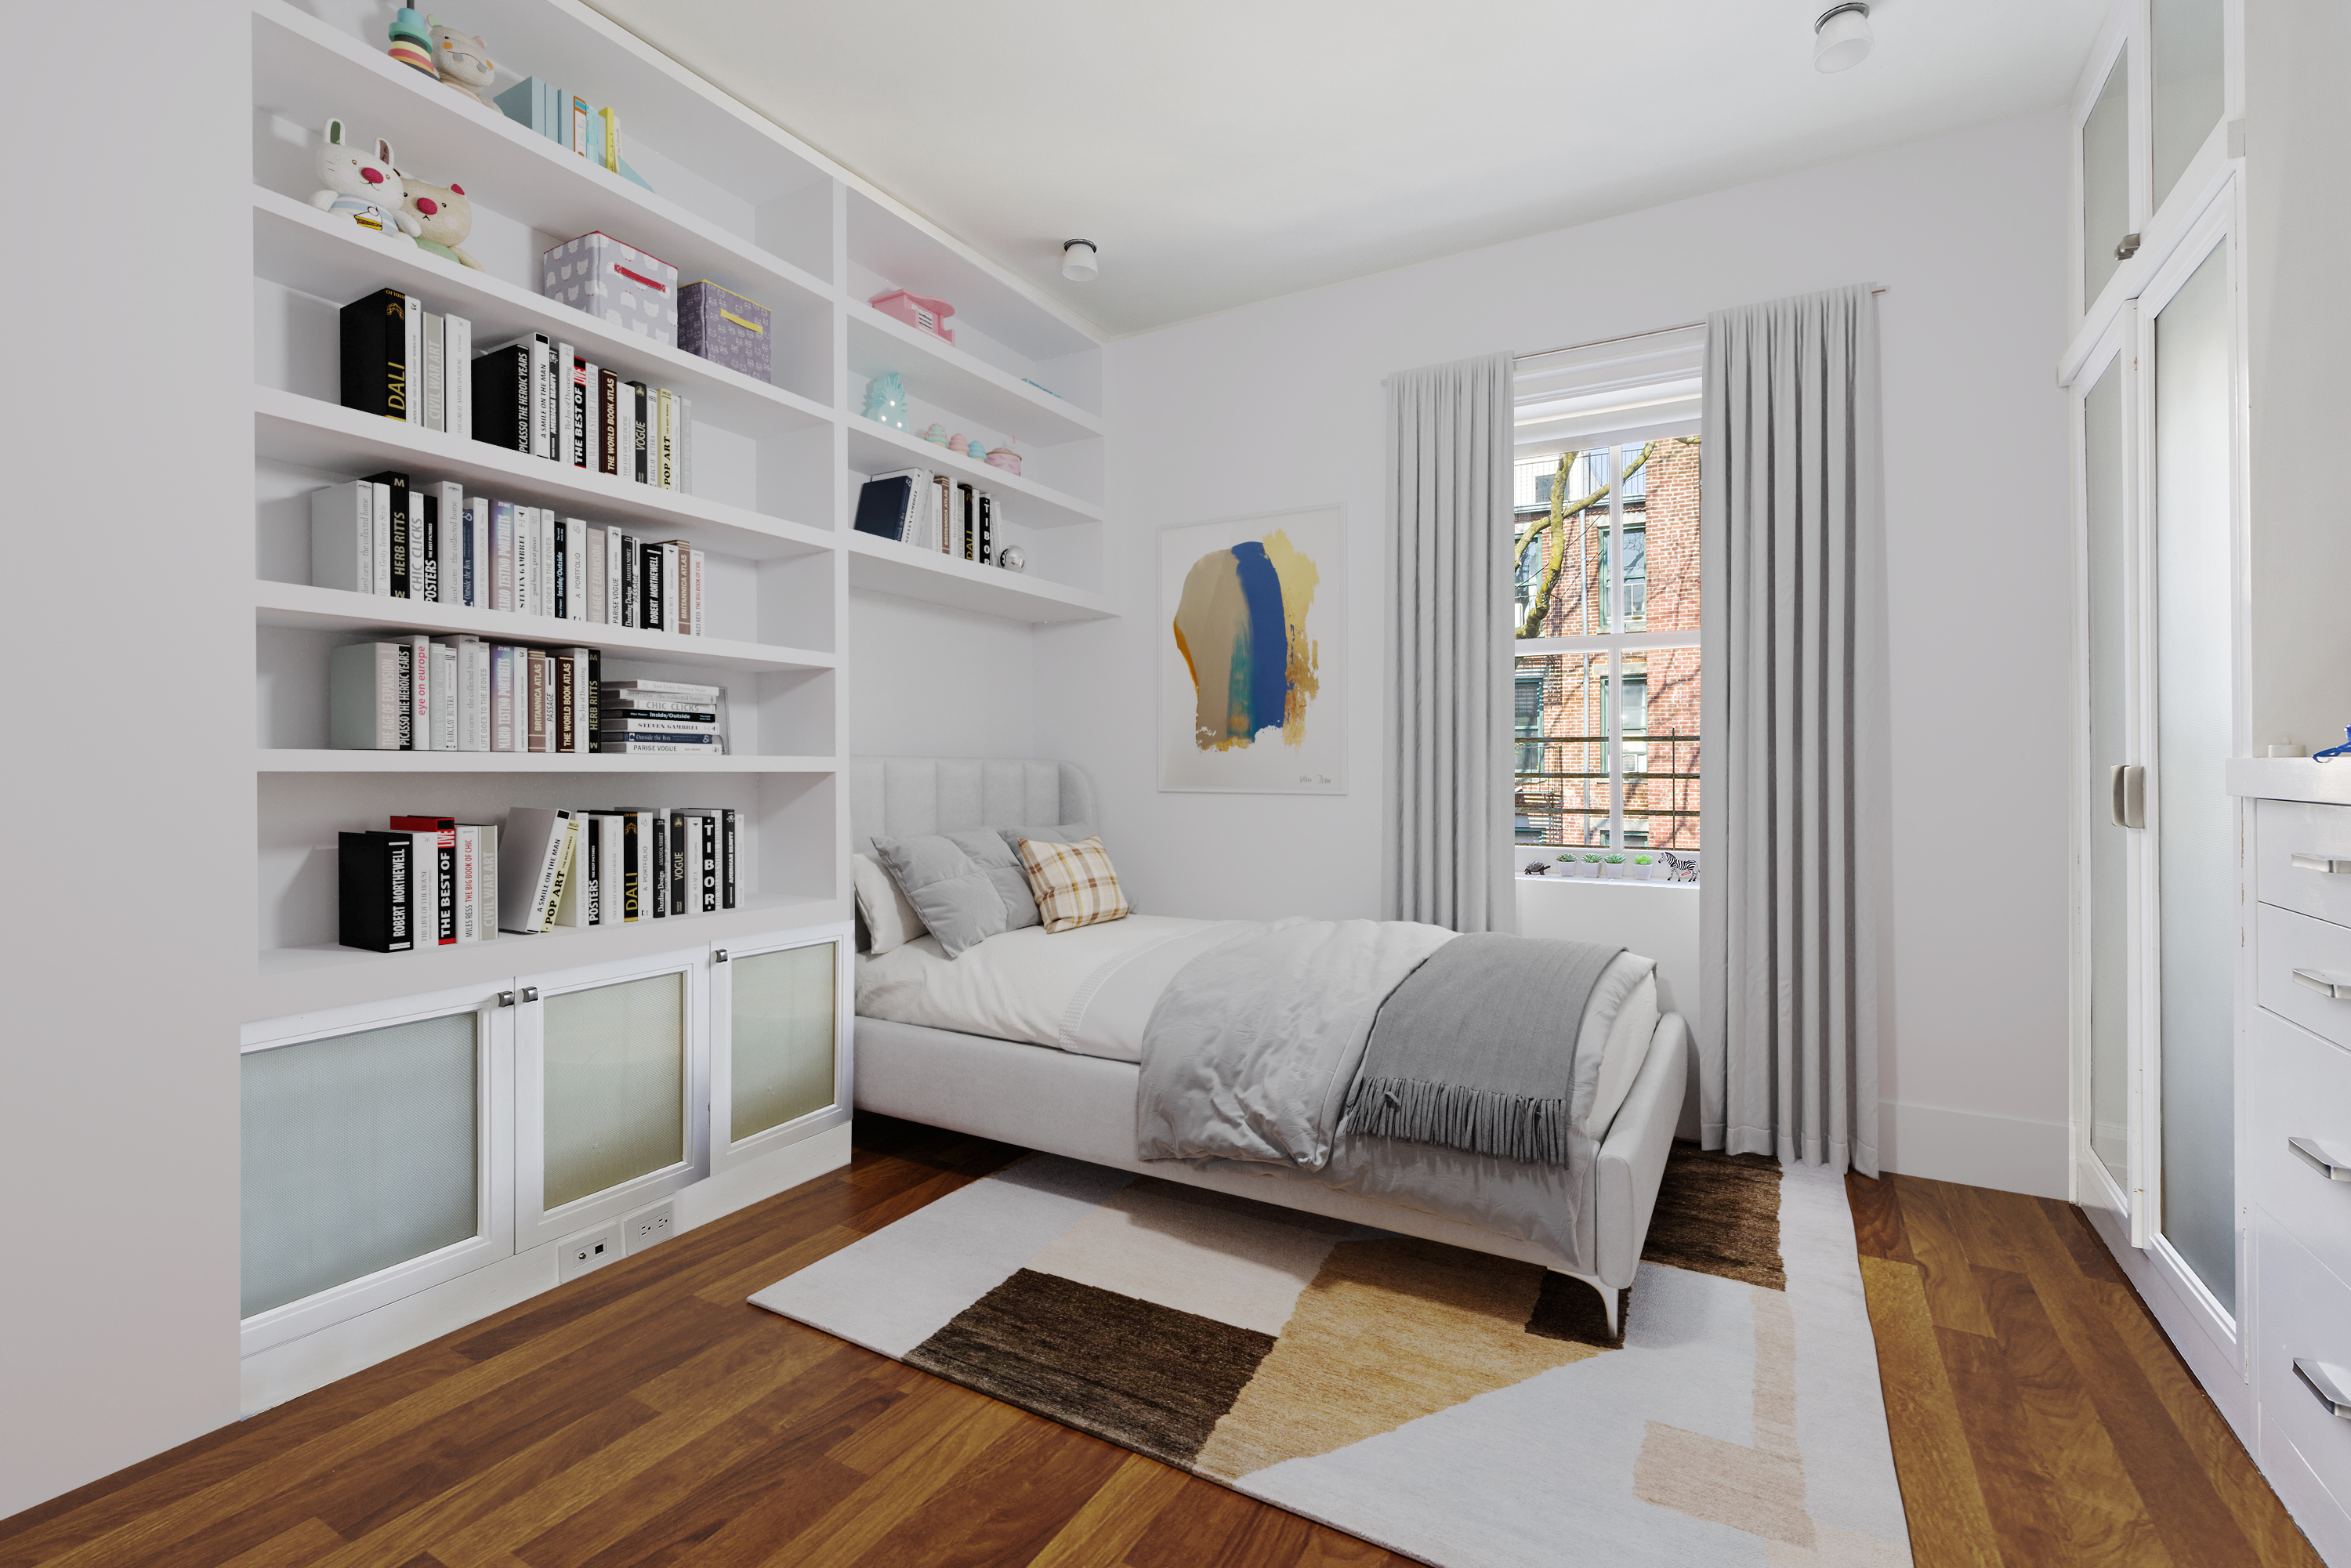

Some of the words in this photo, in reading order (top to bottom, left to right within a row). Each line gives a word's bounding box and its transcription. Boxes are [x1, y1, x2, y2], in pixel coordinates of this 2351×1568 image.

[429, 340, 440, 363] ART
[429, 364, 440, 389] WAR
[518, 353, 528, 377] YEARS
[388, 362, 404, 410] DALI
[518, 376, 528, 403] HEROIC
[574, 387, 583, 404] OF
[429, 389, 440, 419] CIVIL
[518, 403, 528, 422] THE
[541, 396, 546, 409] ON
[574, 405, 583, 437] BEST
[518, 421, 528, 453] PICASSO
[636, 421, 646, 451] VOGUE
[574, 439, 583, 463] THE
[360, 498, 368, 516] home
[360, 517, 368, 545] collected
[394, 512, 405, 543] RITTS
[411, 518, 422, 558] CLICKS
[360, 545, 368, 556] the
[379, 549, 388, 567] Getty
[394, 545, 405, 575] HERB
[411, 563, 422, 592] CHIC
[498, 558, 511, 588] TESTINO
[592, 544, 602, 585] EXPANSION
[649, 556, 659, 598] MORTHEWELL
[425, 559, 437, 602] POSTERS
[592, 585, 602, 595] OF
[592, 596, 602, 610] AGE
[649, 599, 659, 625] ROBERT
[399, 650, 410, 673] YEARS
[418, 646, 427, 681] europe
[382, 659, 394, 701] EXPANSION
[399, 674, 410, 700] HEROIC
[418, 683, 426, 696] on
[589, 680, 598, 704] RITTS
[382, 704, 394, 713] OF
[399, 701, 410, 715] THE
[418, 698, 427, 715] eye
[480, 706, 487, 715] TO
[498, 697, 511, 725] TESTINO
[589, 707, 598, 730] HERB
[647, 701, 666, 710] CHIC
[672, 703, 699, 712] CLICKS
[650, 712, 690, 720] Inside/Outside
[382, 715, 394, 729] AGE
[399, 716, 410, 745] PICASSO
[382, 731, 394, 746] THE
[498, 726, 511, 748] MARIO
[440, 853, 451, 871] OF
[483, 852, 494, 871] ART
[538, 885, 549, 906] SMILE
[545, 873, 552, 883] ON
[552, 839, 560, 856] MAN
[674, 852, 683, 881] VOGUE
[704, 824, 715, 905] TIBOR
[393, 849, 405, 904] MORTHEWELL
[483, 874, 494, 899] WAR
[440, 873, 451, 907] BEST
[545, 900, 556, 925] POP
[552, 871, 565, 897] ART
[589, 880, 599, 922] POSTERS
[625, 872, 638, 911] DALI
[393, 906, 405, 937] ROBERT
[440, 910, 451, 937] THE
[483, 900, 494, 927] CIVIL
